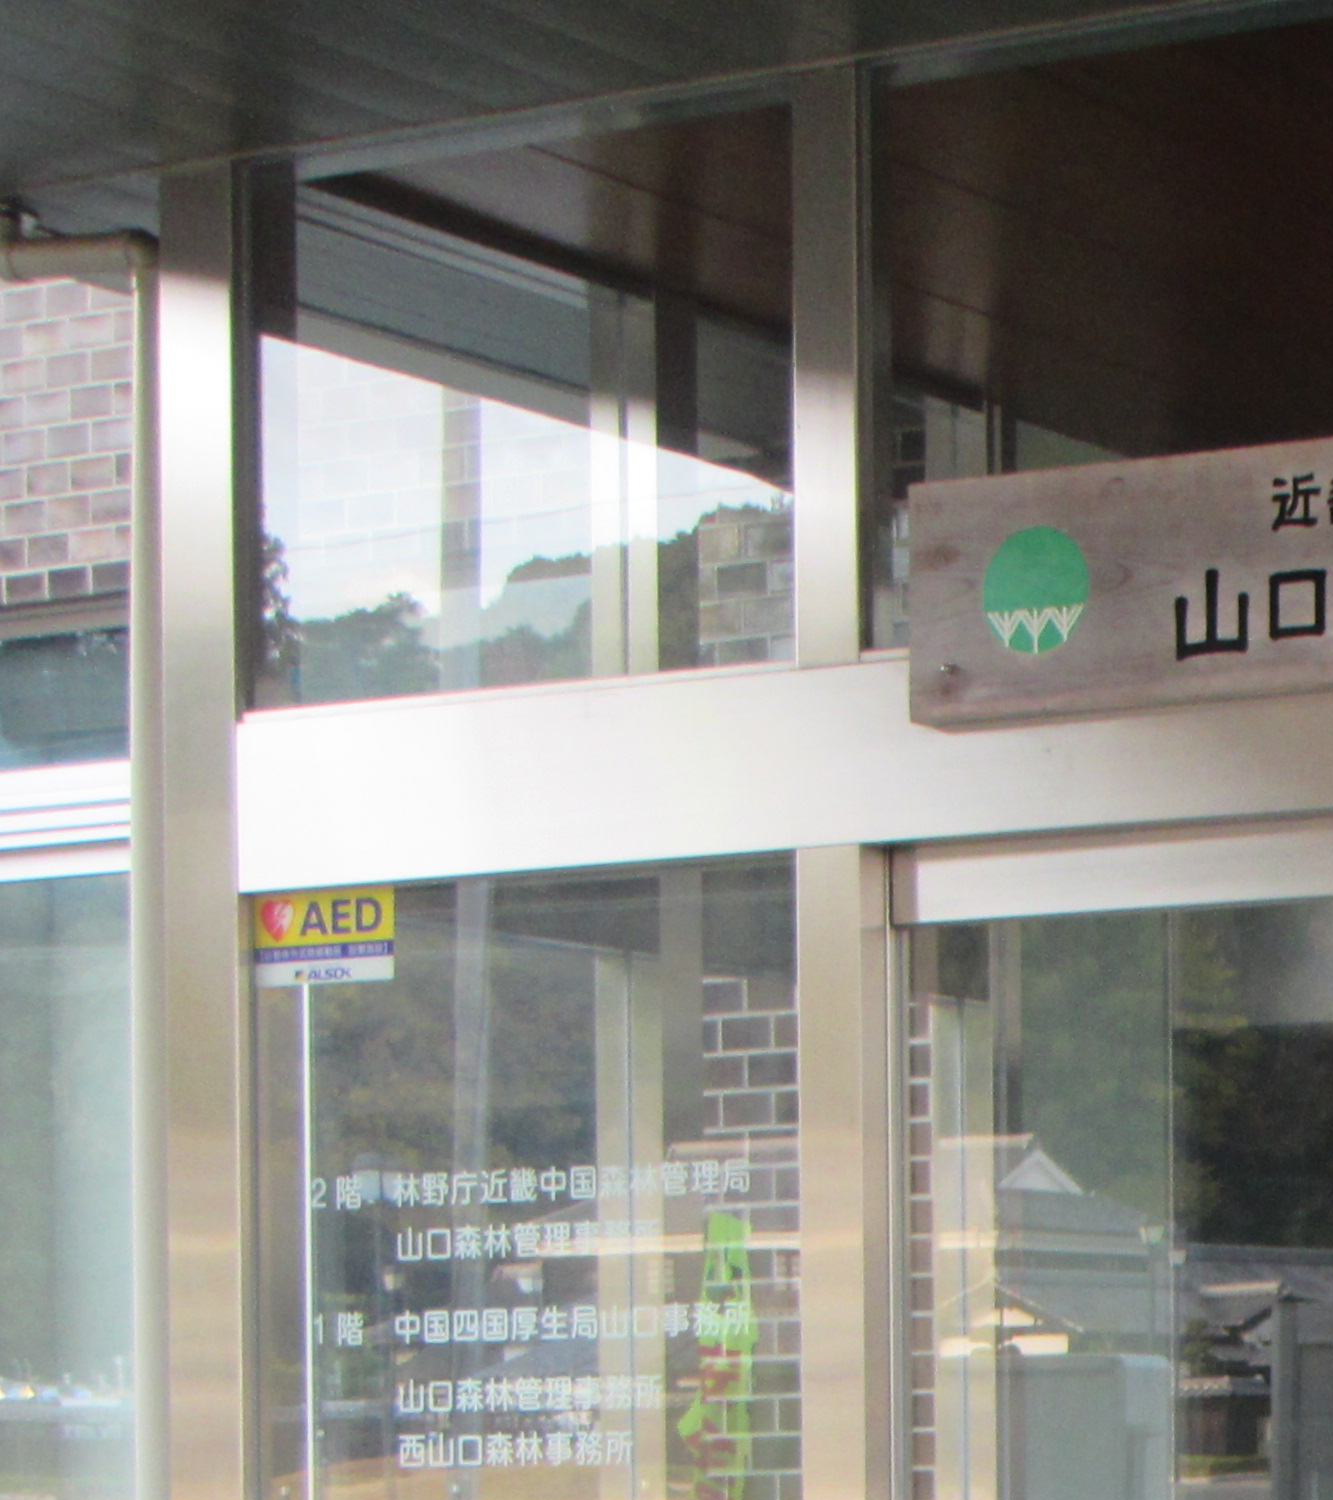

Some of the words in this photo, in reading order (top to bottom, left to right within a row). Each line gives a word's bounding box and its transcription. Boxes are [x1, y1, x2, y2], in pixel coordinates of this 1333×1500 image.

[300, 897, 383, 936] AED
[399, 1430, 633, 1468] 西山口森林事務所
